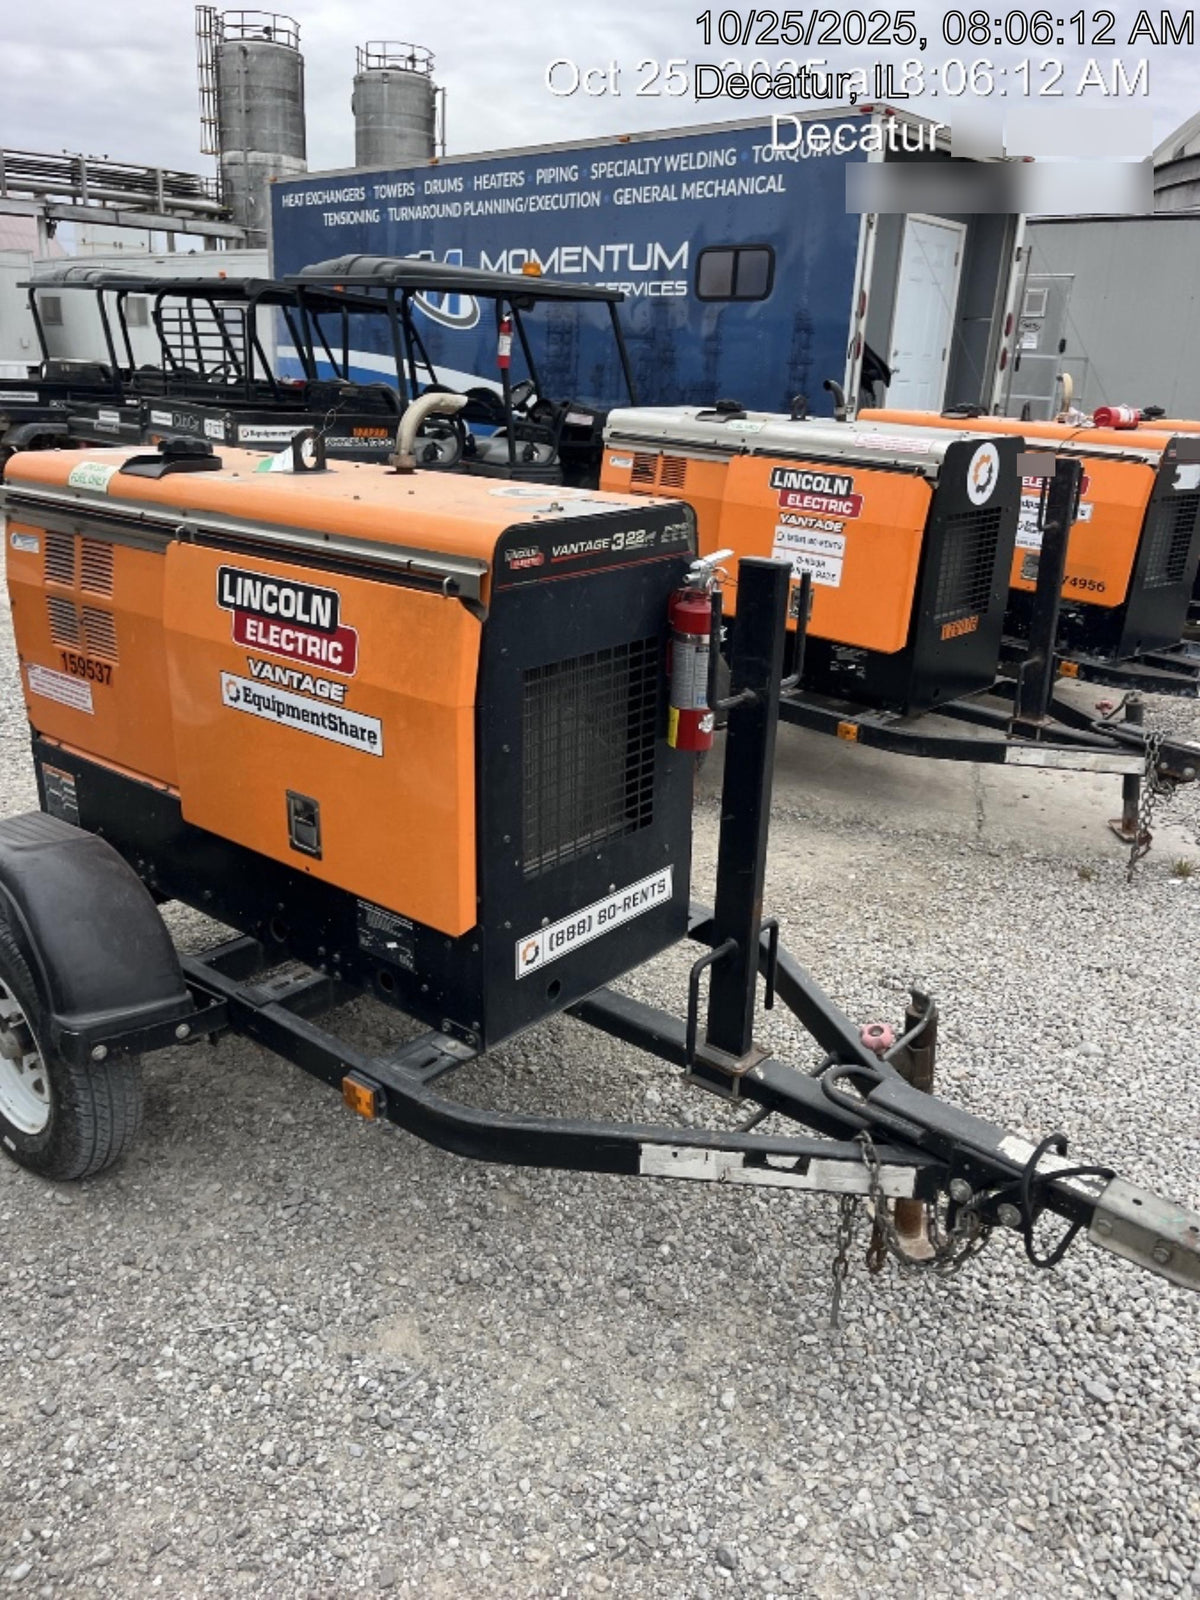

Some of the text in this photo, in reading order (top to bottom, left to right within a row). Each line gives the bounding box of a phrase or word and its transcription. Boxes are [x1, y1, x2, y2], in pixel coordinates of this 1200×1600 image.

[282, 193, 304, 208] HEAT
[305, 186, 365, 206] EXCHANGERS
[372, 182, 416, 200] TOWERS
[424, 177, 464, 195] DRUMS
[473, 170, 525, 191] HEATERS
[535, 164, 579, 186] PIPING
[590, 155, 662, 179] SPECIALTY
[664, 148, 737, 172] WELDING
[323, 174, 786, 227] TENSIONING TURNAROUND PLANNING/EXECUTION GENERAL MECHANICAL
[481, 241, 689, 275] MOMENTUM
[773, 471, 848, 495] LINCOLN
[787, 494, 853, 514] ELECTRIC
[780, 513, 843, 532] VANTAGE
[551, 538, 611, 557] VANTAGE
[223, 573, 332, 628] LINCOLN
[245, 618, 343, 665] ELECTRIC
[60, 652, 113, 685] 159537
[247, 657, 346, 703] VANTAGE
[242, 686, 378, 745] EquipmentShare
[549, 878, 666, 951] (888) 80-RENTS
